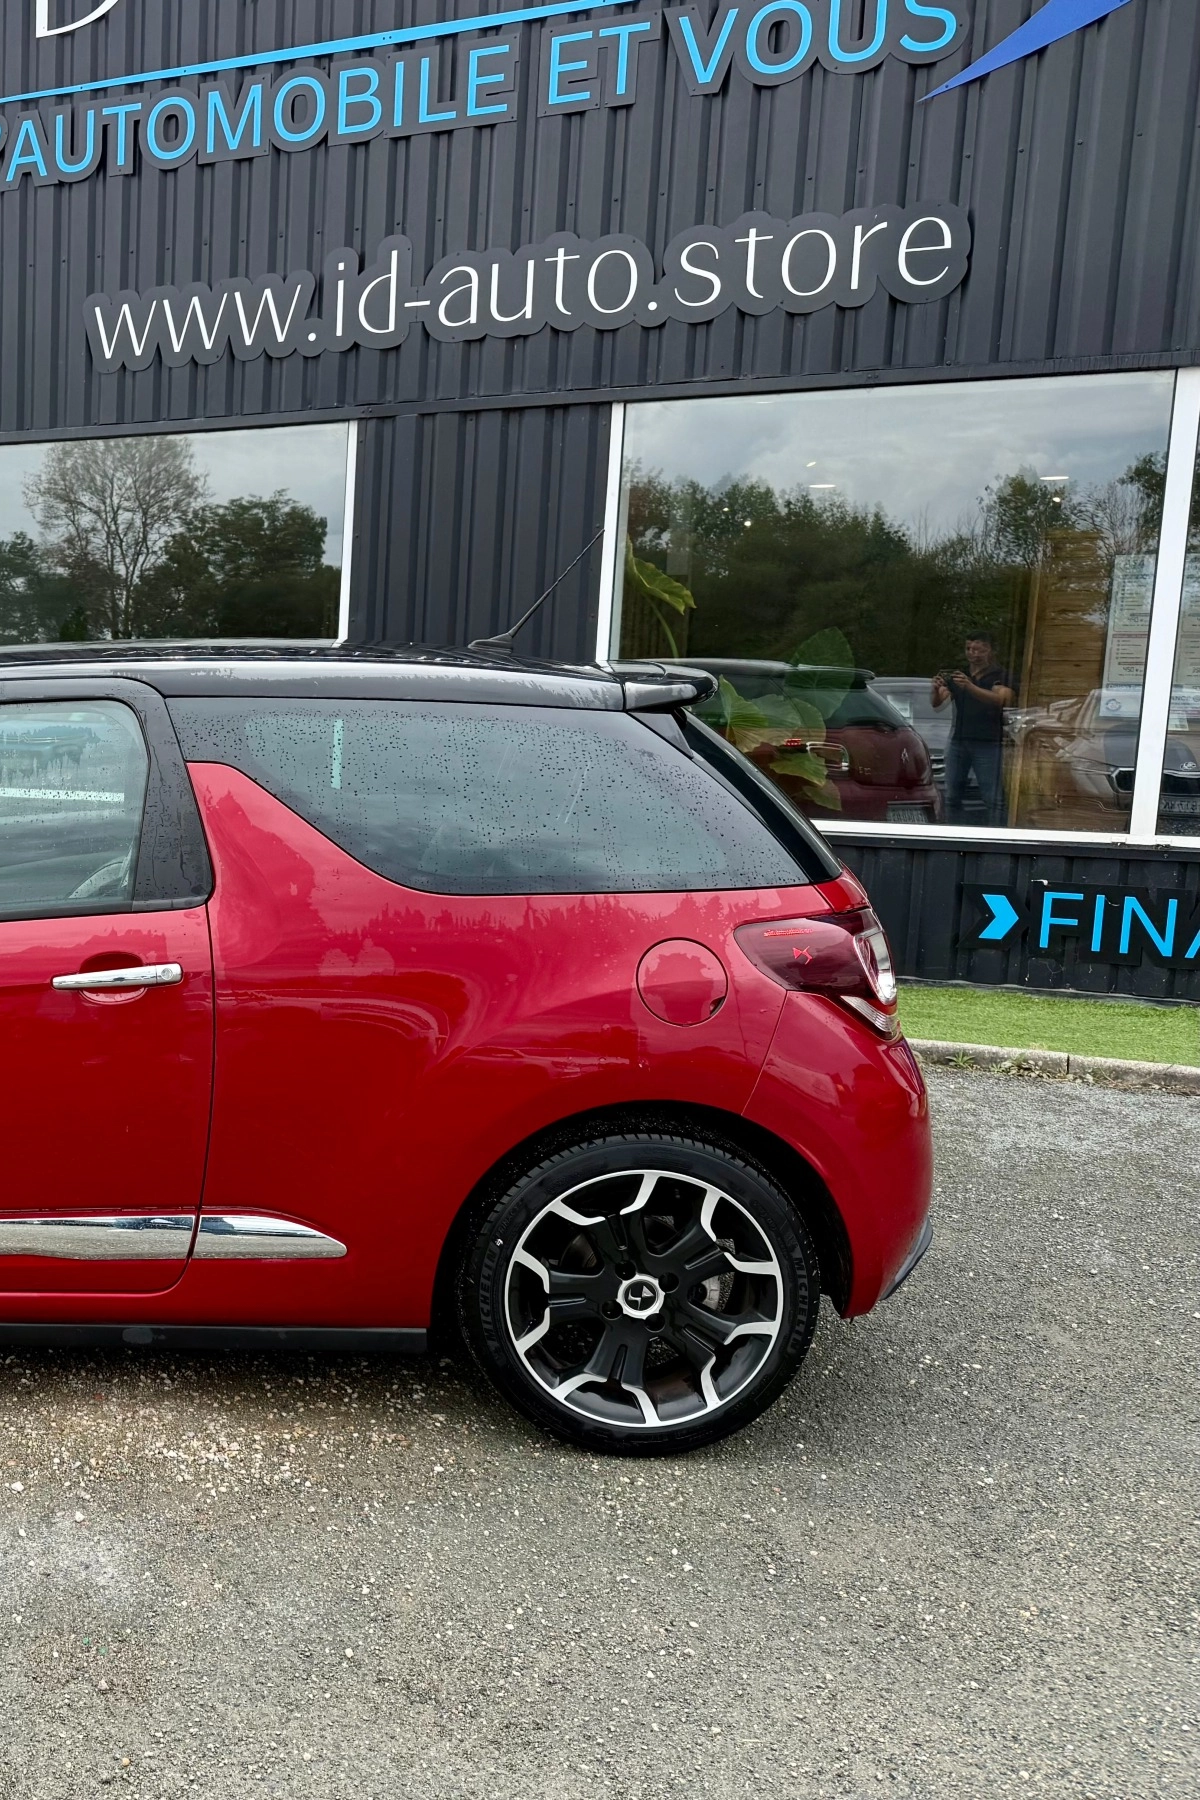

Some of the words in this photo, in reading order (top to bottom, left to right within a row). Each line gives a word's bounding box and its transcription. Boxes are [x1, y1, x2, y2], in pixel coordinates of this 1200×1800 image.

[548, 21, 652, 106] ET
[678, 0, 958, 85] VOUS
[93, 215, 954, 361] www.id-auto.store
[1038, 890, 1200, 960] FIN
[479, 1247, 498, 1342] MICHELIN
[788, 1256, 809, 1351] MICHELIN
